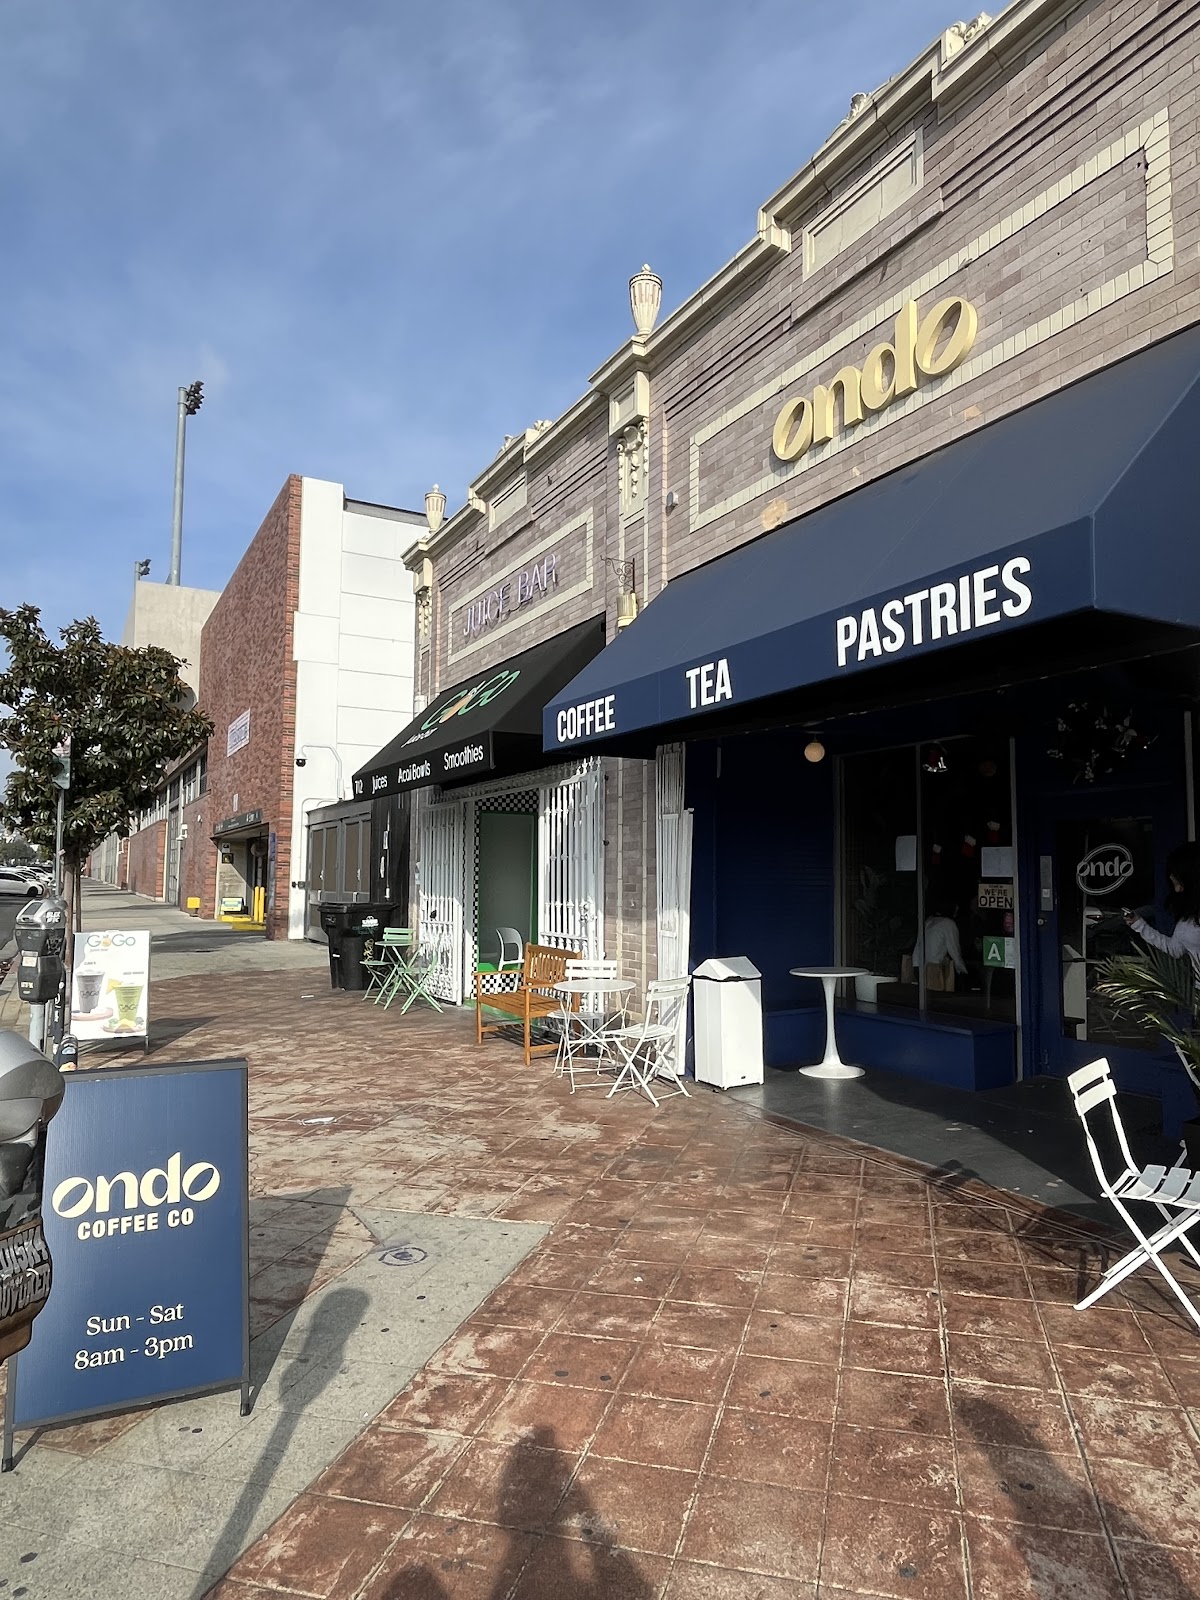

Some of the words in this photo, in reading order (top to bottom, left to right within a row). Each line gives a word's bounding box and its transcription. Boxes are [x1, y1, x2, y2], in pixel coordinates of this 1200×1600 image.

[772, 296, 977, 461] ondo
[463, 583, 511, 637] JUICE
[518, 553, 557, 604] BAR
[557, 694, 616, 743] COFFEE
[686, 658, 733, 709] TEA
[836, 556, 1032, 667] PASTRIES
[371, 775, 388, 794] Juices
[412, 760, 431, 782] Bowls
[443, 744, 484, 771] Smoothies
[1076, 856, 1134, 878] ondo
[980, 896, 1013, 908] OPEN
[984, 888, 1007, 897] WE'RE
[987, 942, 1002, 961] A
[51, 1152, 221, 1219] ondo
[77, 1212, 159, 1240] COFFEE
[167, 1207, 195, 1229] CO
[86, 1314, 131, 1337] Sun
[149, 1303, 185, 1326] Sat
[74, 1348, 125, 1371] 8am
[144, 1332, 194, 1361] 3pm
